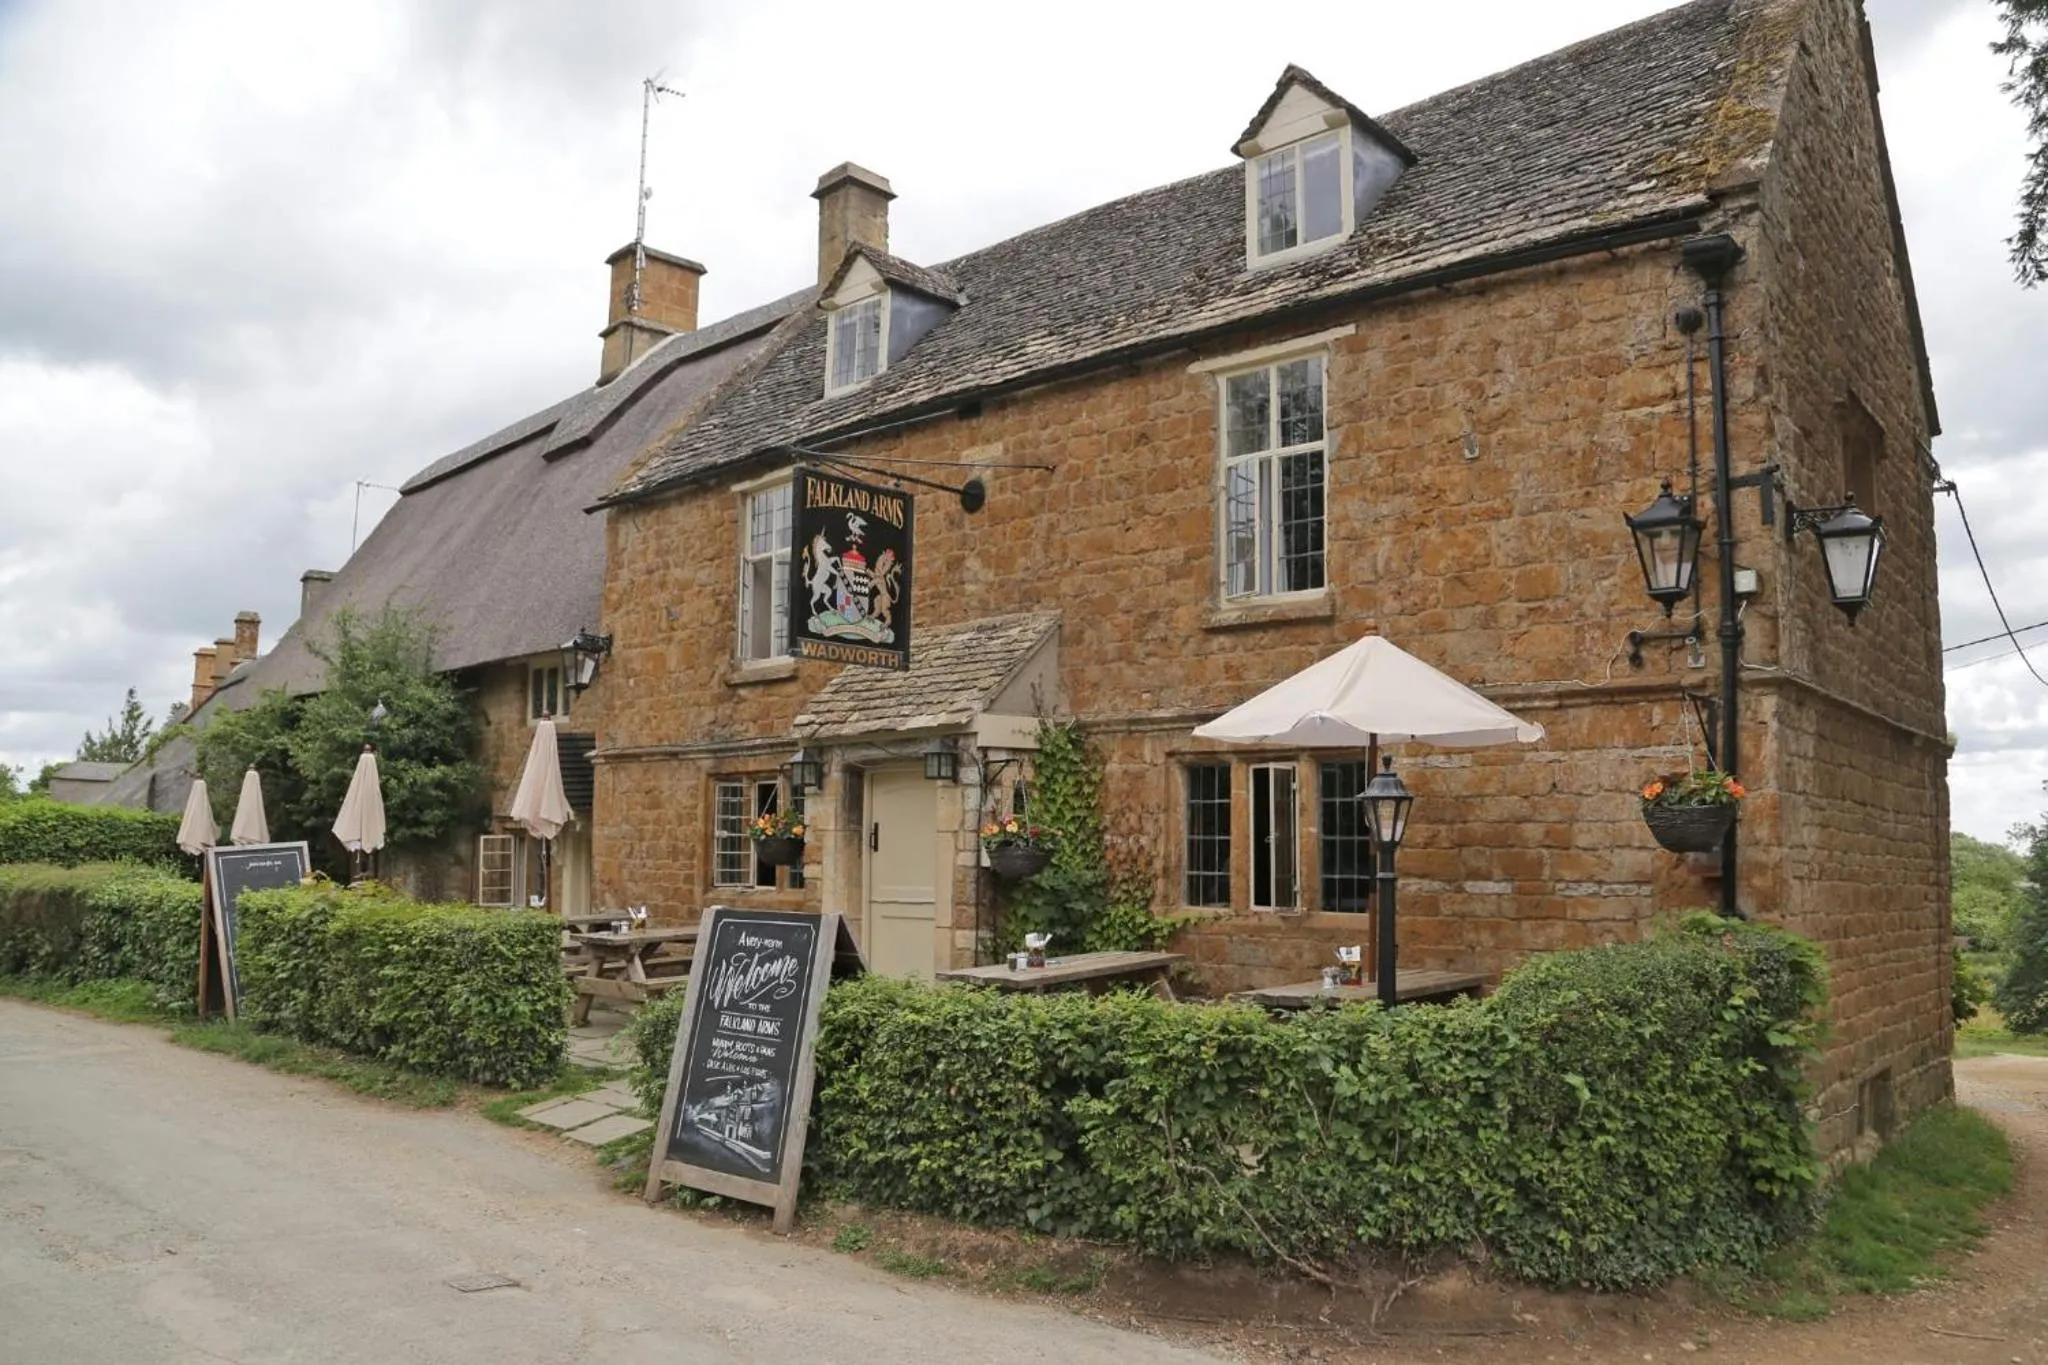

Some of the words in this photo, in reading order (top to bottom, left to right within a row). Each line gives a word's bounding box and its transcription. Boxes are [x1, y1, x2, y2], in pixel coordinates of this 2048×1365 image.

[806, 476, 870, 512] FALKLAND
[871, 498, 904, 530] ARMS
[801, 640, 899, 668] WADWORTH
[709, 950, 800, 1009] Welcome
[748, 1002, 757, 1010] TO
[719, 1014, 756, 1032] FALKLAND
[757, 1019, 781, 1036] ARMS
